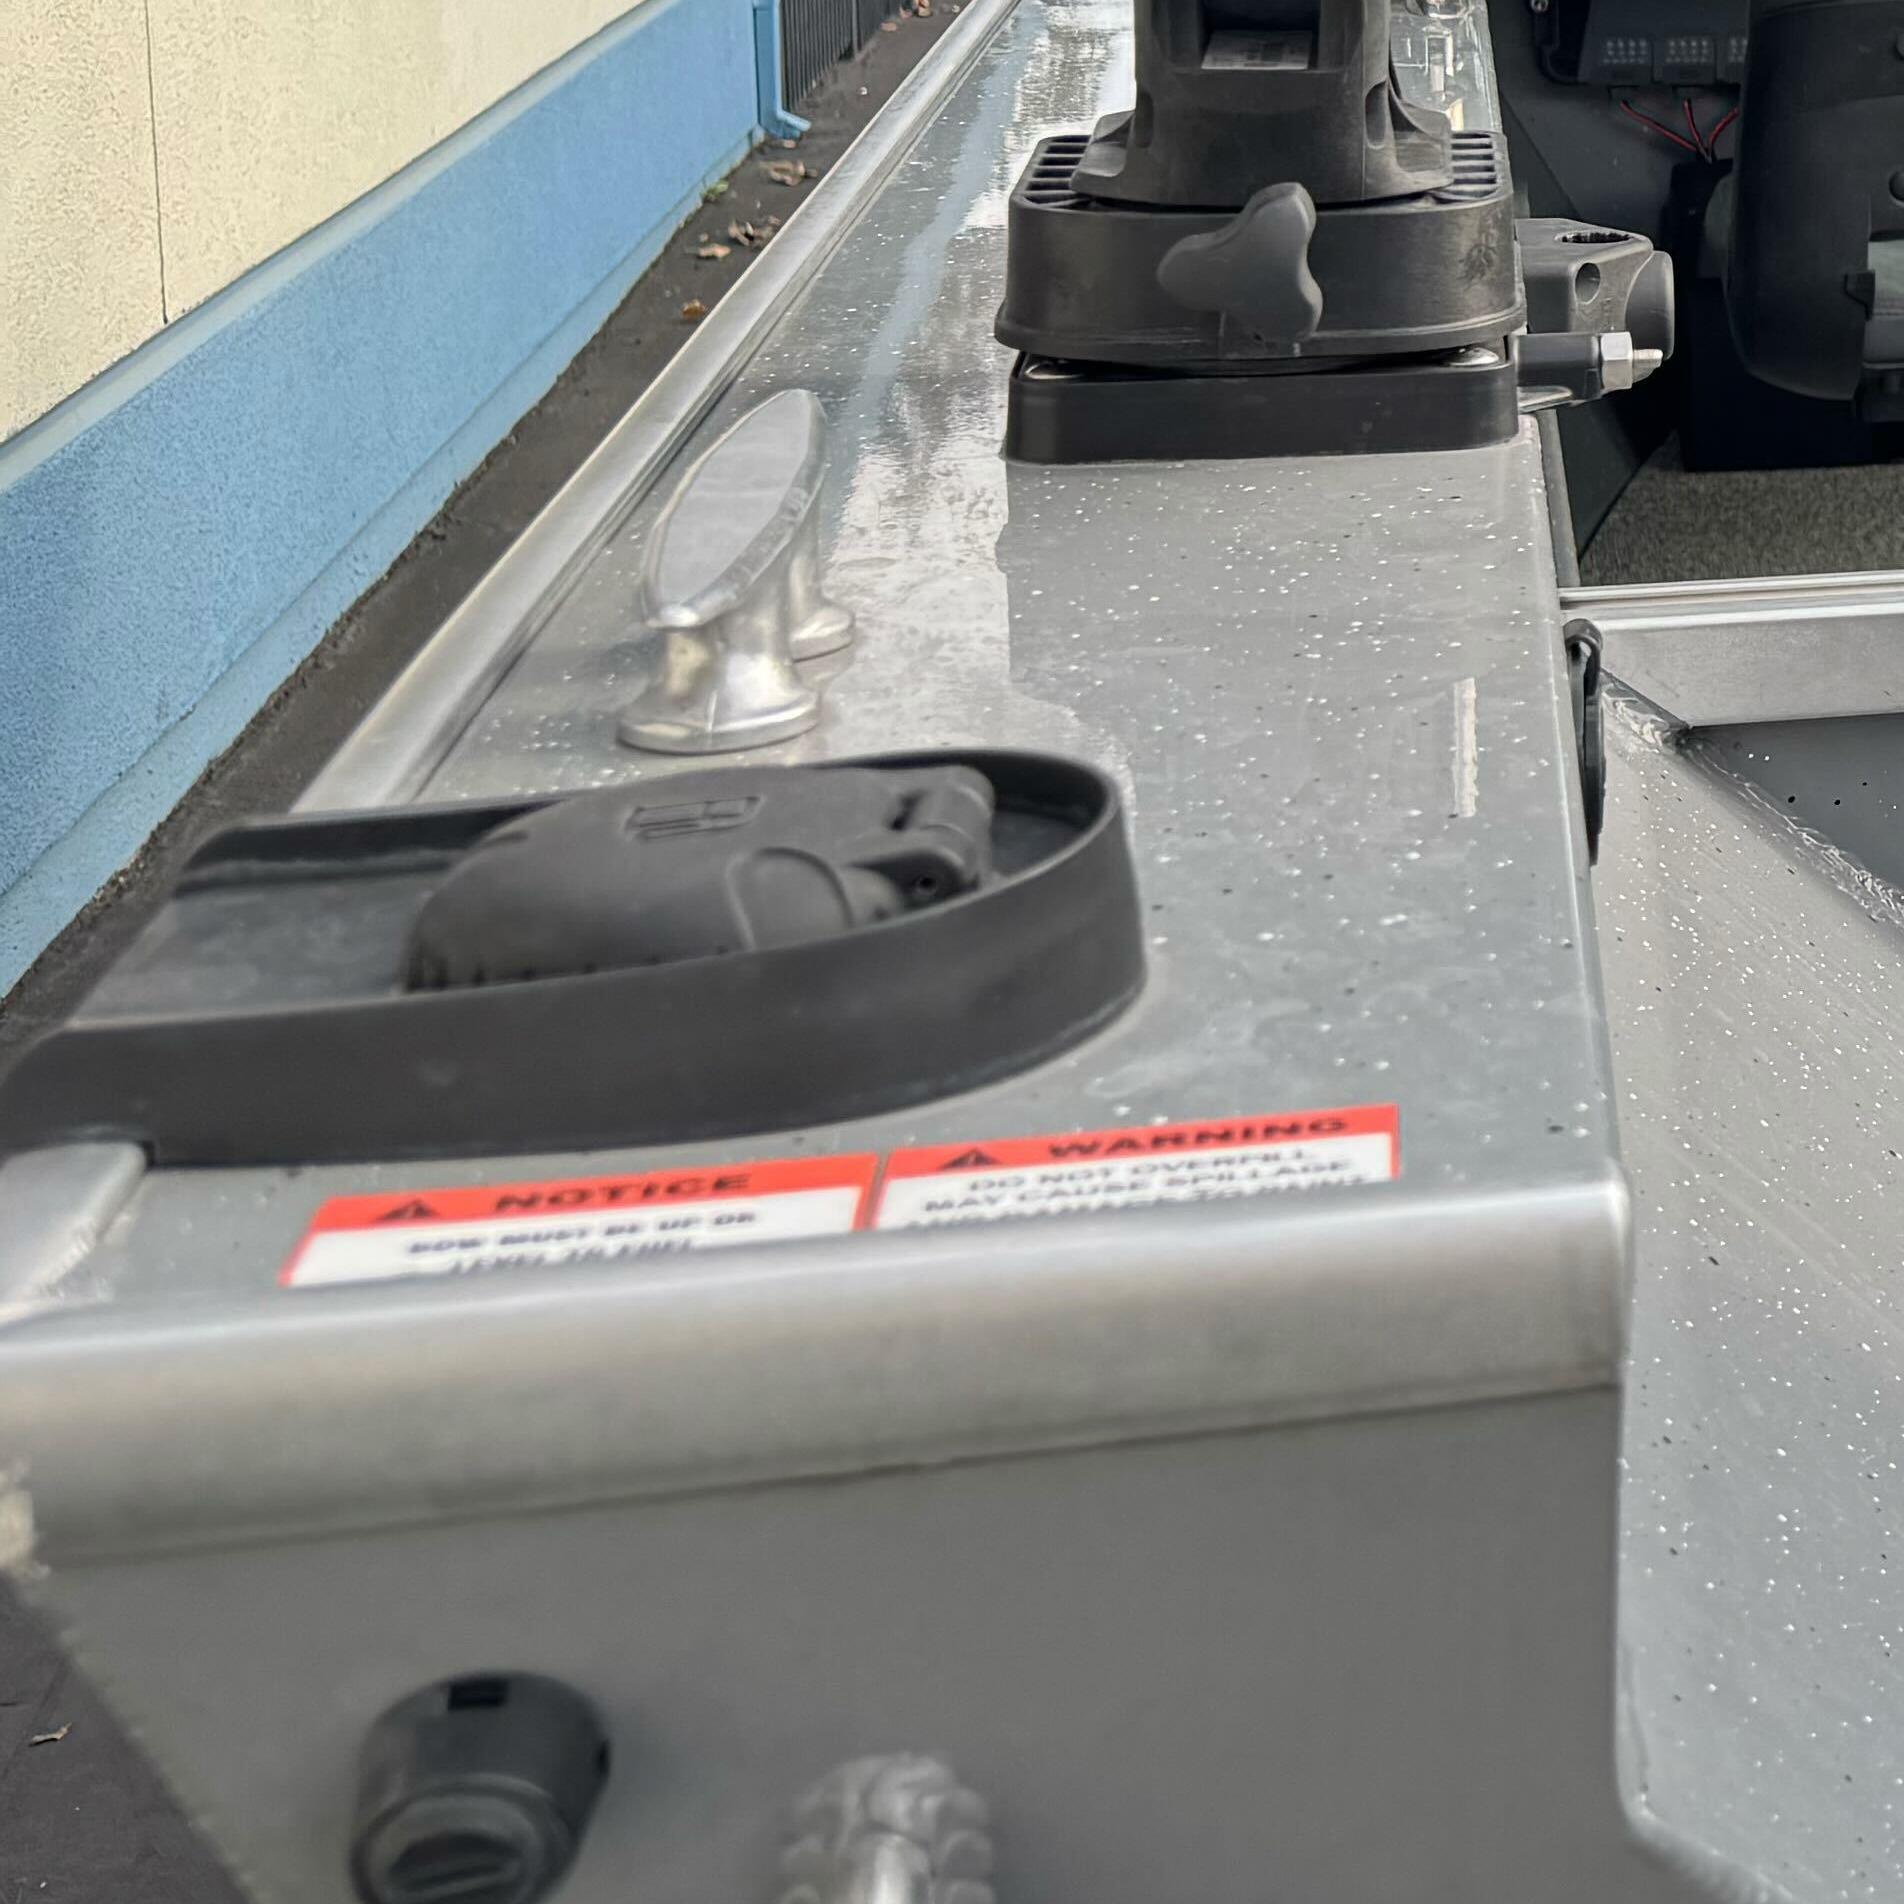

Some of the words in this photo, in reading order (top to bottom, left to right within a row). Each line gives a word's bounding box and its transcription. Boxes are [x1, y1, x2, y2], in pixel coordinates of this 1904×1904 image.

[1048, 1117, 1347, 1157] WARNING
[495, 1173, 752, 1211] NOTICE
[969, 1175, 1025, 1191] DO
[1039, 1168, 1112, 1184] NOT
[925, 1195, 1004, 1212] MAY
